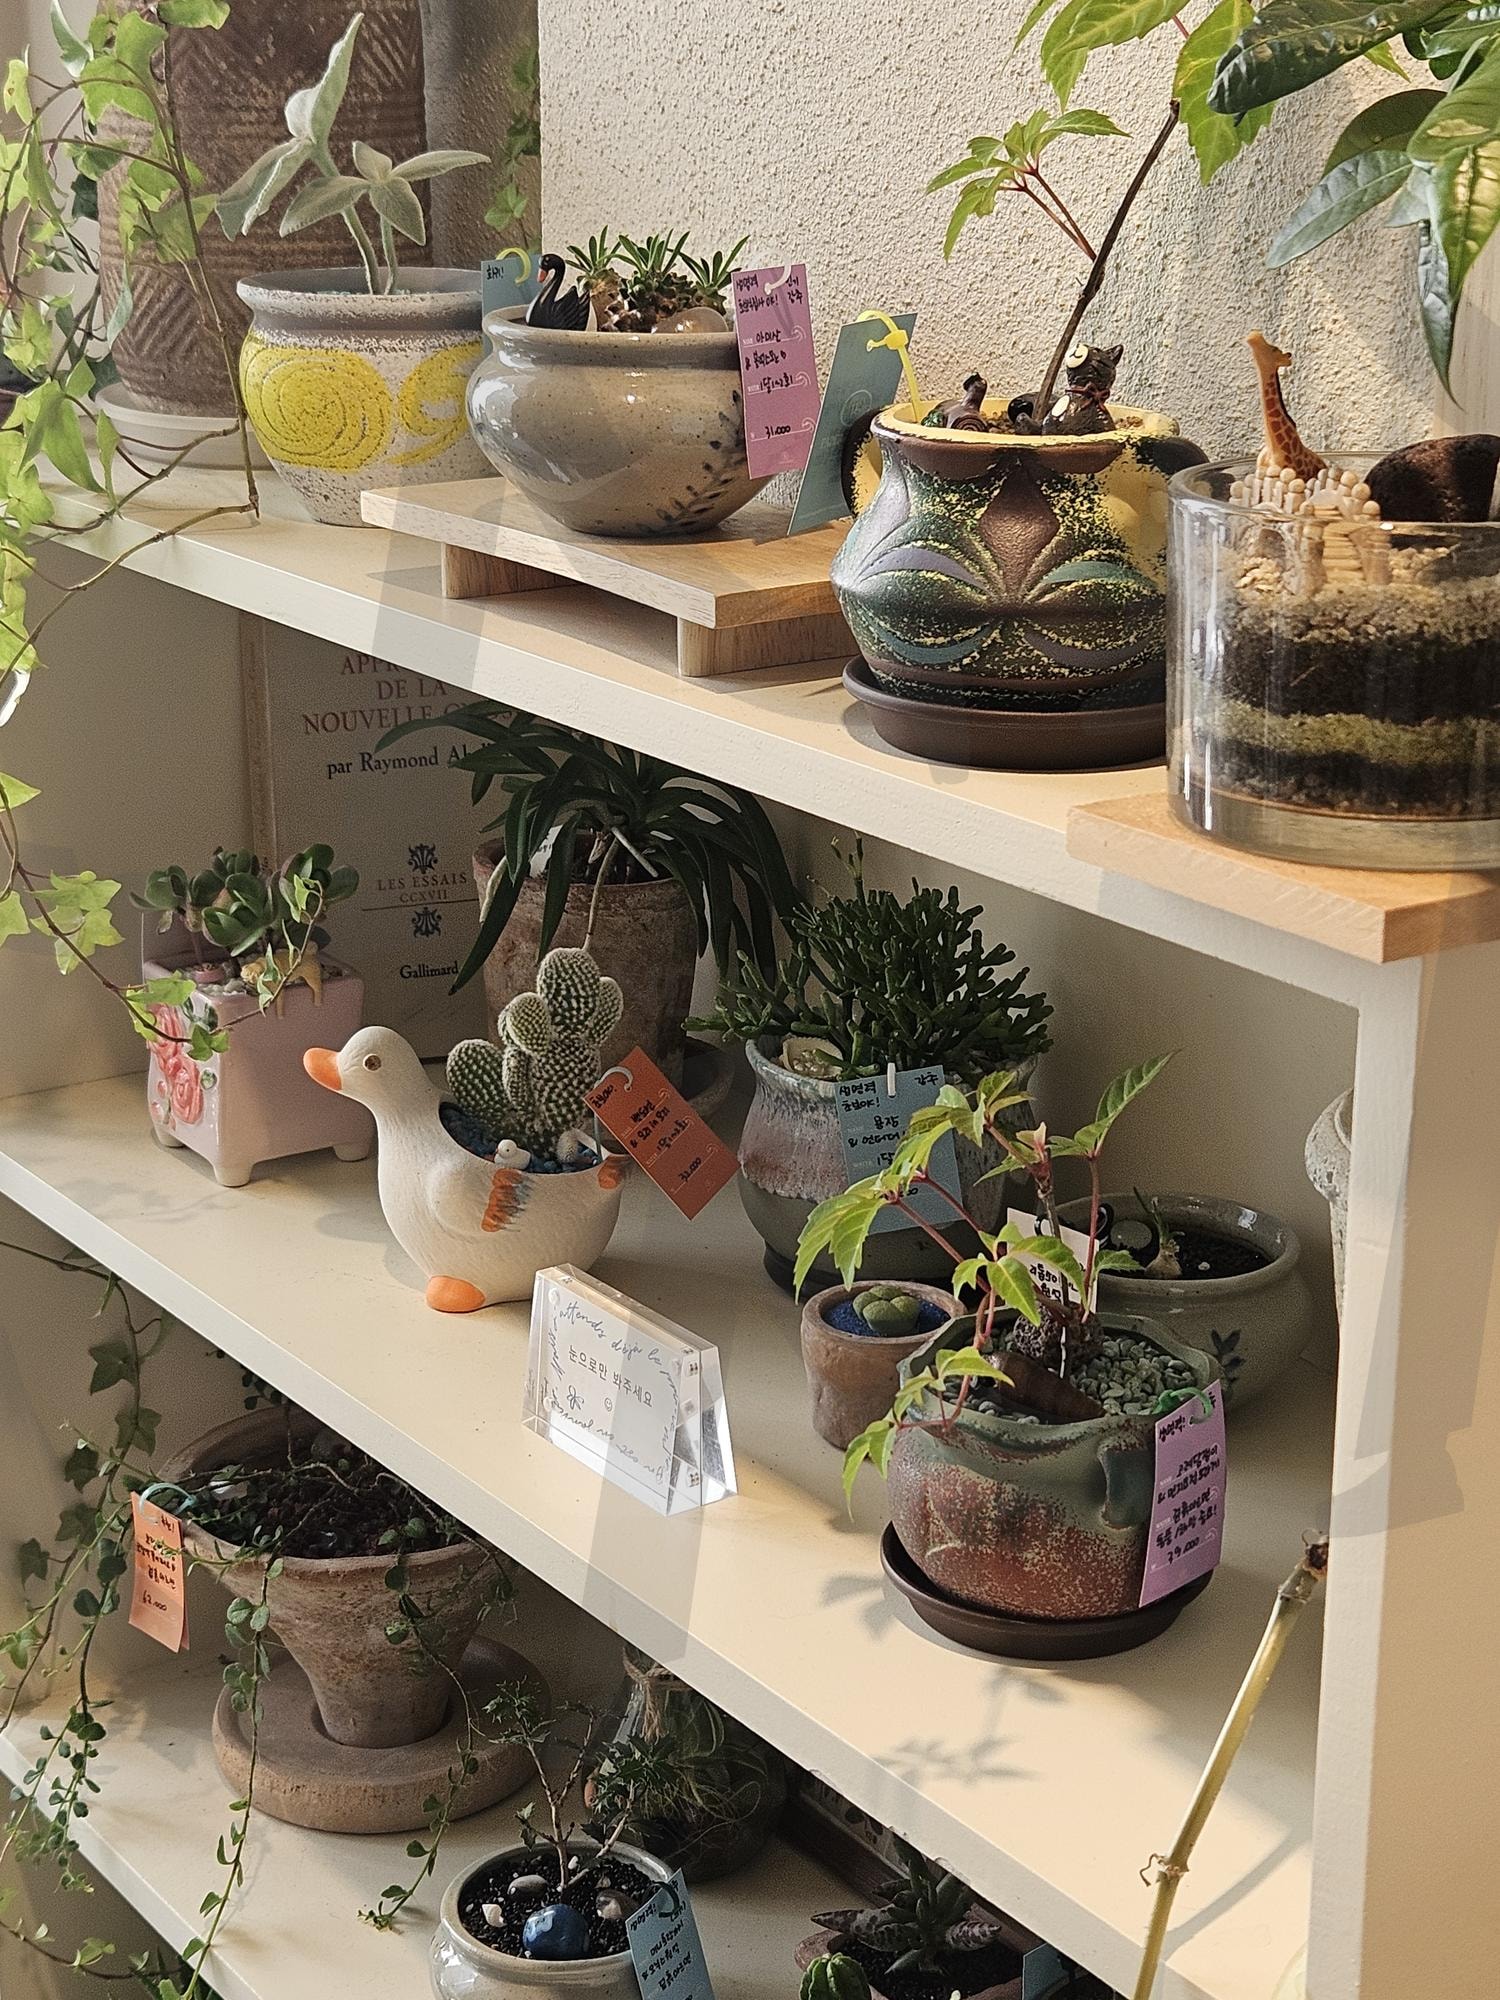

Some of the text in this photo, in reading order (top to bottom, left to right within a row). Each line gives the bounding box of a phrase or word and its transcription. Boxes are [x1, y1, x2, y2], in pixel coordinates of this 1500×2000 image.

[376, 678, 448, 700] DE LA
[327, 761, 352, 779] par
[360, 747, 439, 775] Raymond
[378, 871, 467, 892] LES ESSAIS
[400, 961, 459, 979] Gallimard
[839, 1080, 877, 1097] 생명력
[914, 1071, 939, 1086] 강추
[568, 1345, 653, 1408] 눈으로만 봐주세요
